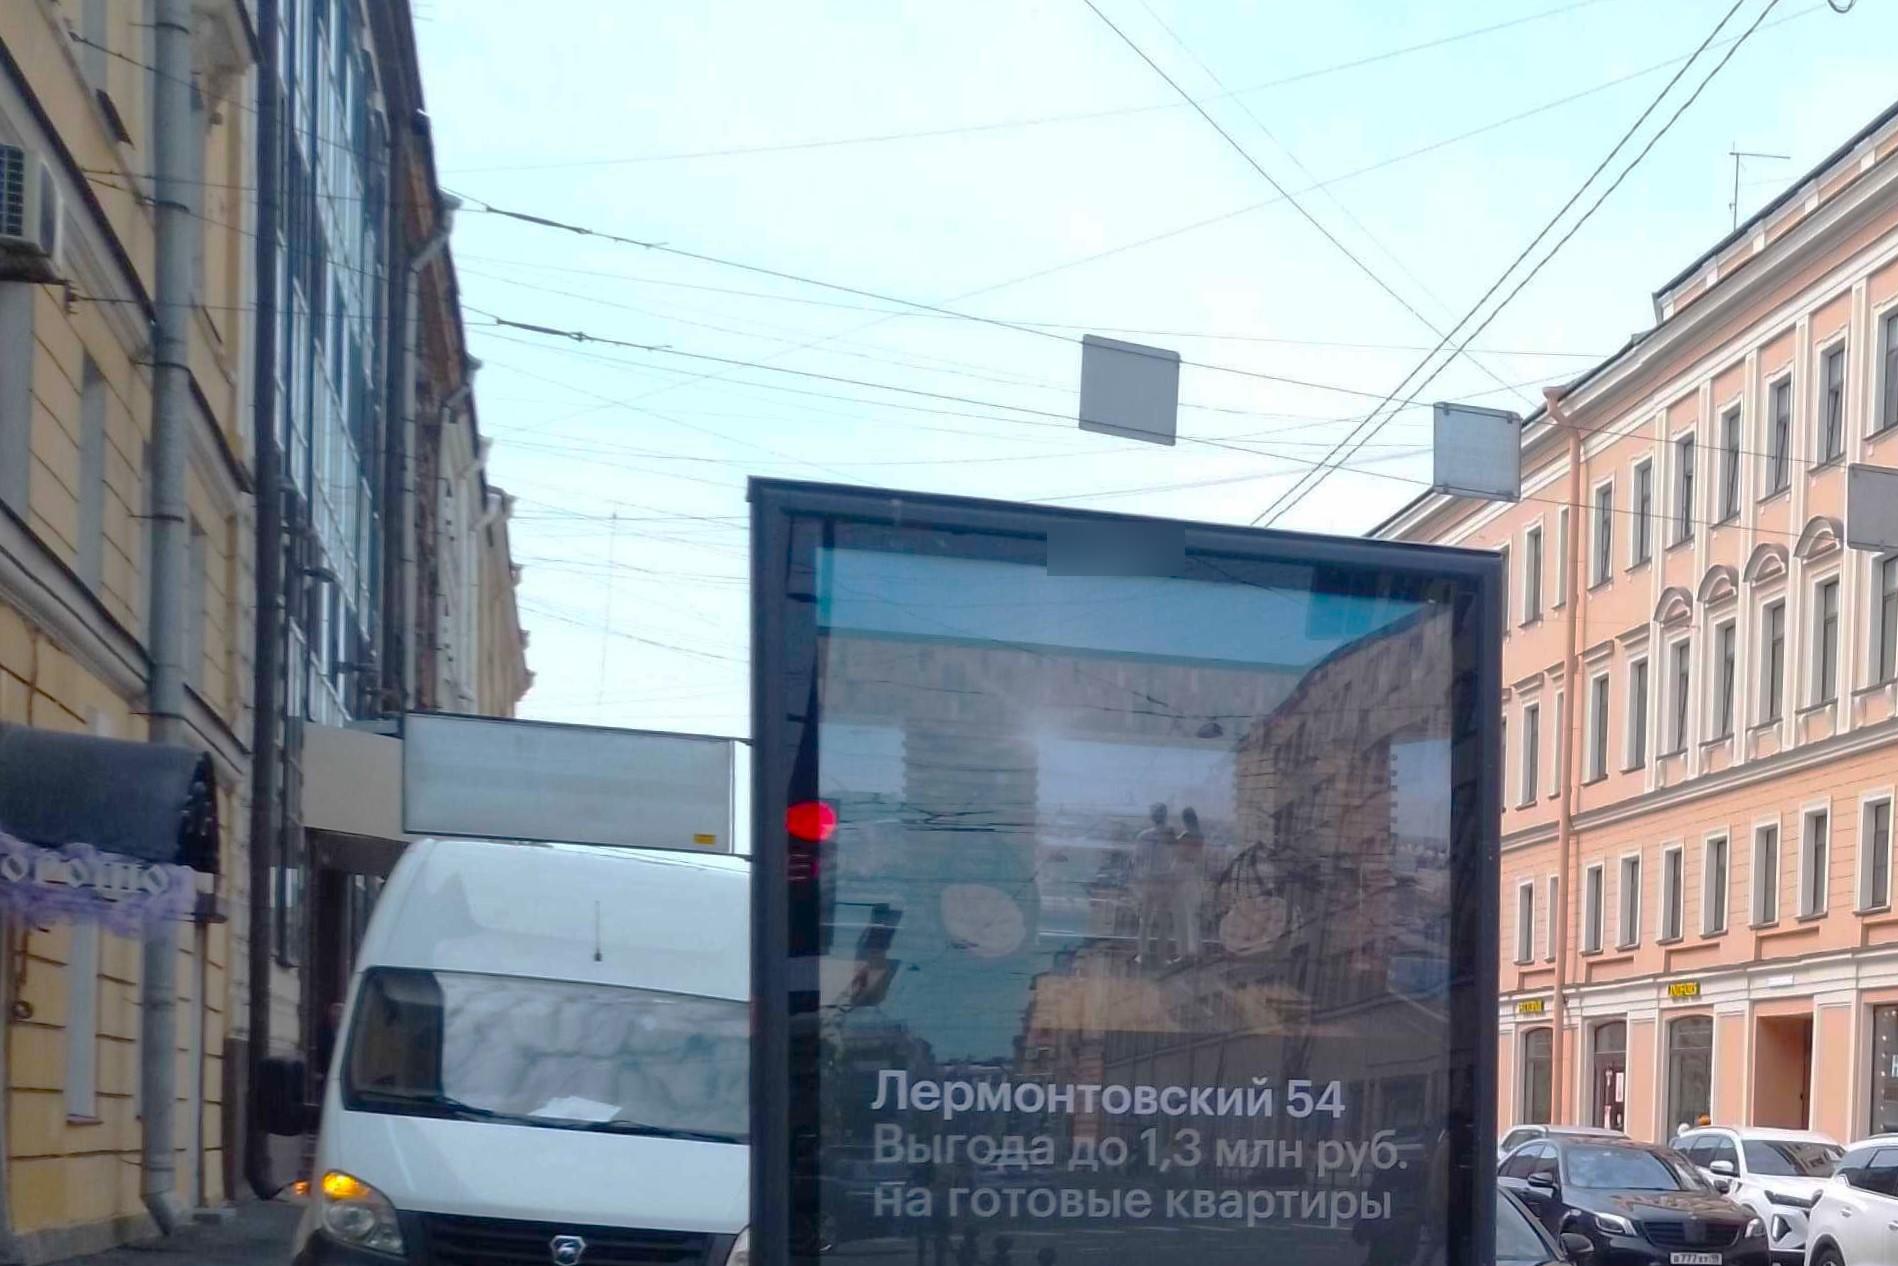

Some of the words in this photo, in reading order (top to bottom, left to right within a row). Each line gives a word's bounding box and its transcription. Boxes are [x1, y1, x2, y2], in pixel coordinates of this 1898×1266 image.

[871, 1069, 1273, 1120] Лермонтовский
[1286, 1079, 1345, 1119] 54
[874, 1123, 1054, 1171] Выгода
[1068, 1136, 1128, 1171] до
[1140, 1127, 1202, 1172] 1,3
[1216, 1138, 1302, 1168] млн
[1318, 1129, 1408, 1178] руб.
[873, 1181, 933, 1217] На
[949, 1187, 1152, 1218] готовые
[1166, 1189, 1392, 1229] квартиры
